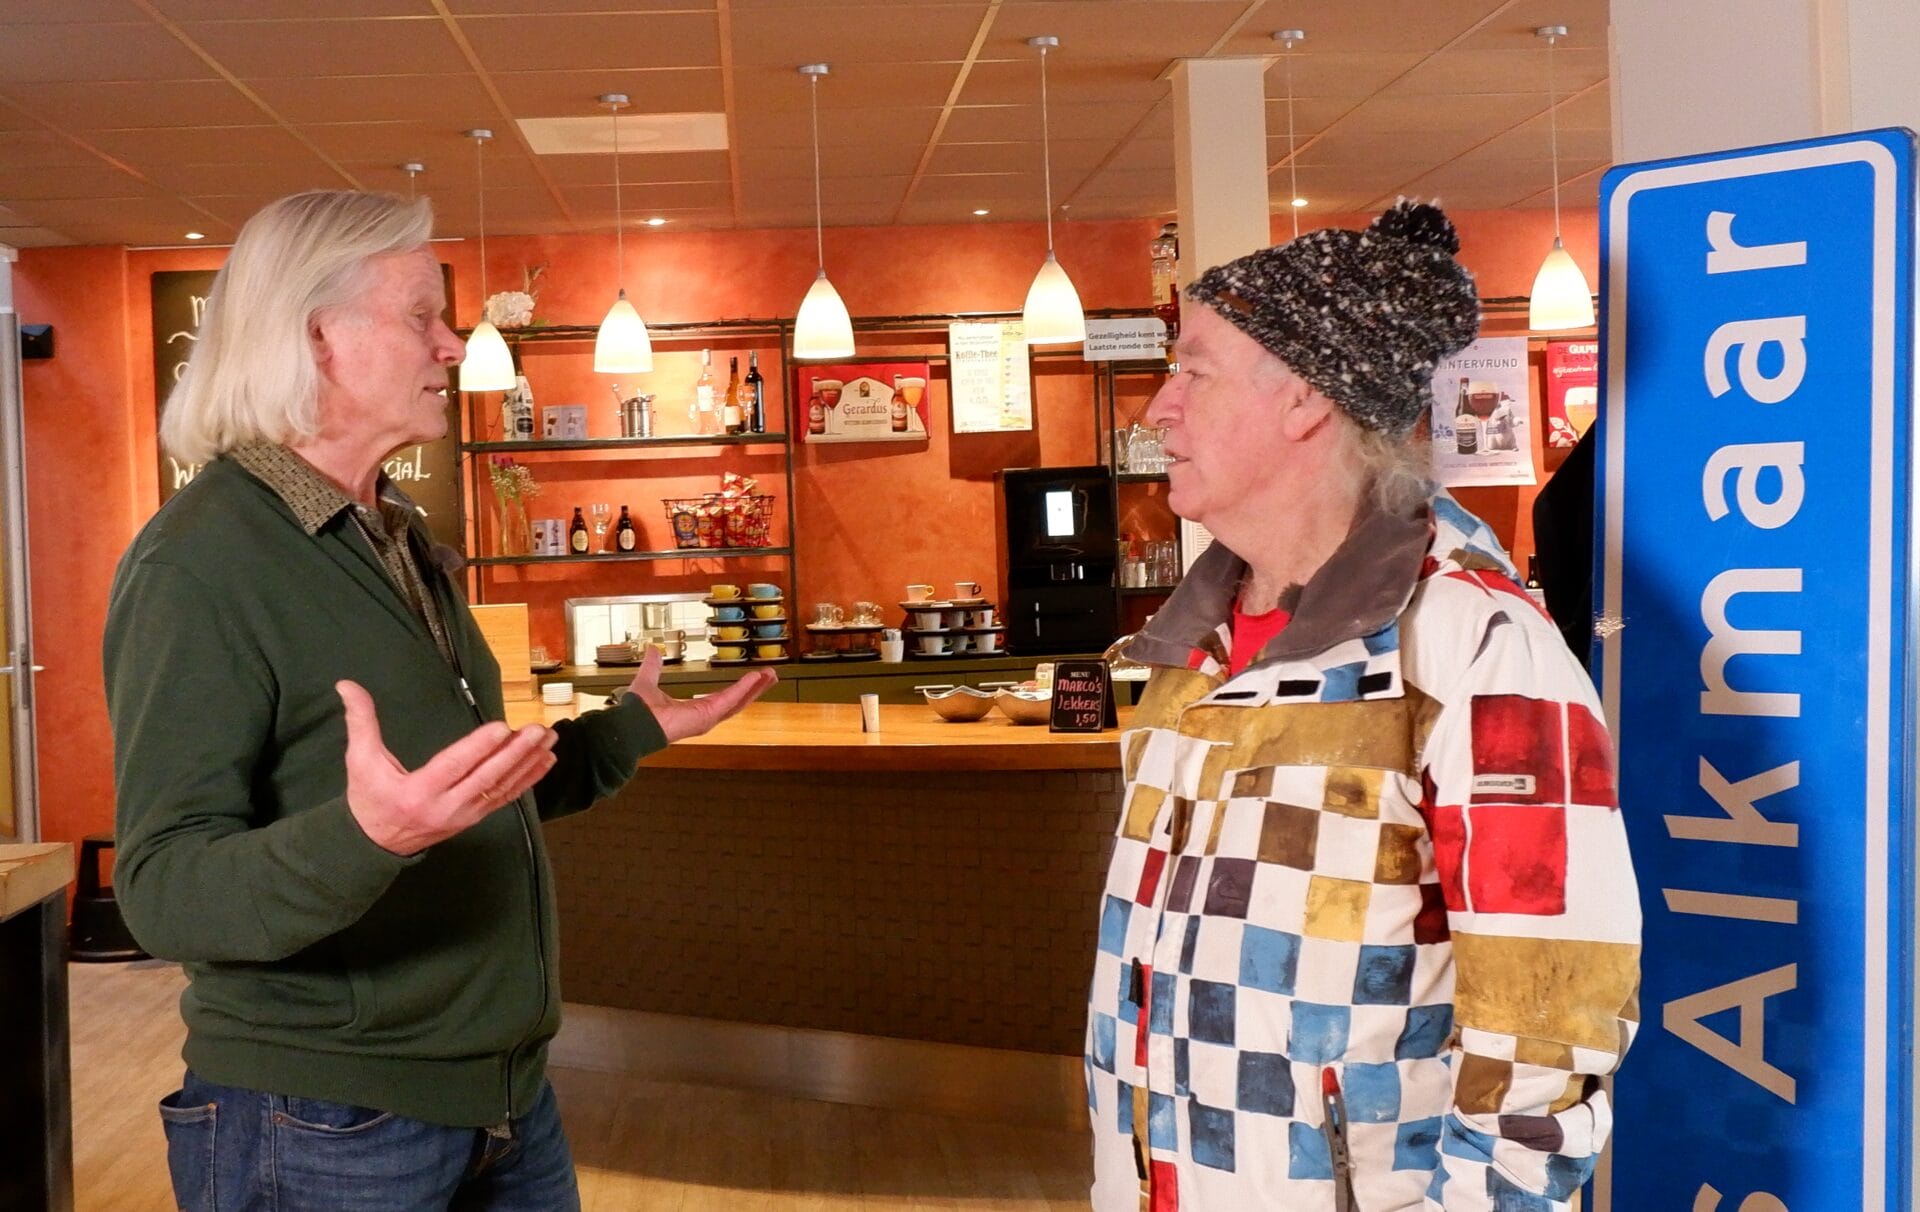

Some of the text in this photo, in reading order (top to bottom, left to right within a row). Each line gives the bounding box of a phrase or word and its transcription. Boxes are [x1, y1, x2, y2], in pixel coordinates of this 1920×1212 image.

[1088, 331, 1137, 341] Gezelligheid
[1088, 343, 1117, 351] Laatste
[1118, 342, 1142, 350] ronde
[842, 399, 888, 416] Gerardus
[1661, 210, 1808, 1105] Alkmaar
